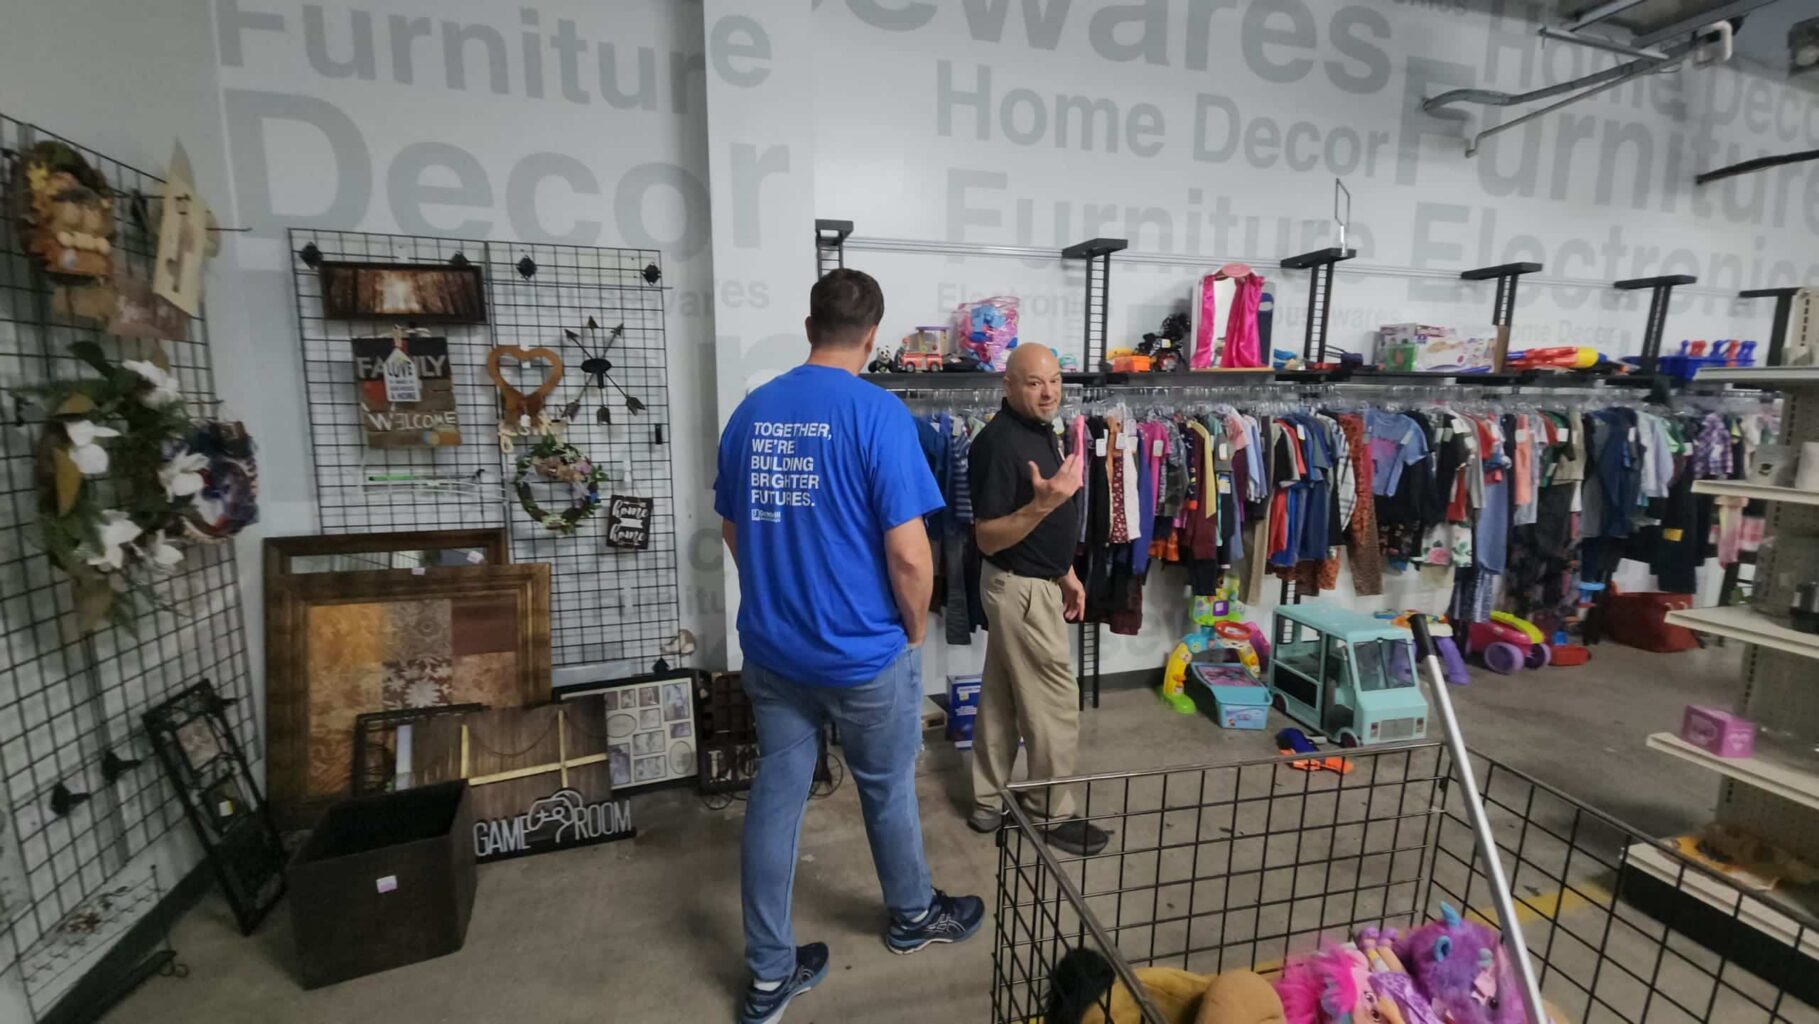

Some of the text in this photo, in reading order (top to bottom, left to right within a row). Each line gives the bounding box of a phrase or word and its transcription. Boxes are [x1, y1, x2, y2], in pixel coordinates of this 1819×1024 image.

[936, 59, 1389, 178] Home Decor
[222, 88, 790, 264] Decor
[355, 353, 446, 379] FAILY
[361, 401, 457, 431] WELCOME
[754, 422, 832, 440] TOGETHER,
[751, 455, 813, 471] BUILDING
[751, 472, 819, 489] BRIGHTER
[751, 489, 815, 506] FUTURES.
[612, 499, 649, 519] home
[610, 523, 647, 542] home
[473, 800, 632, 857] GAME ROOM
